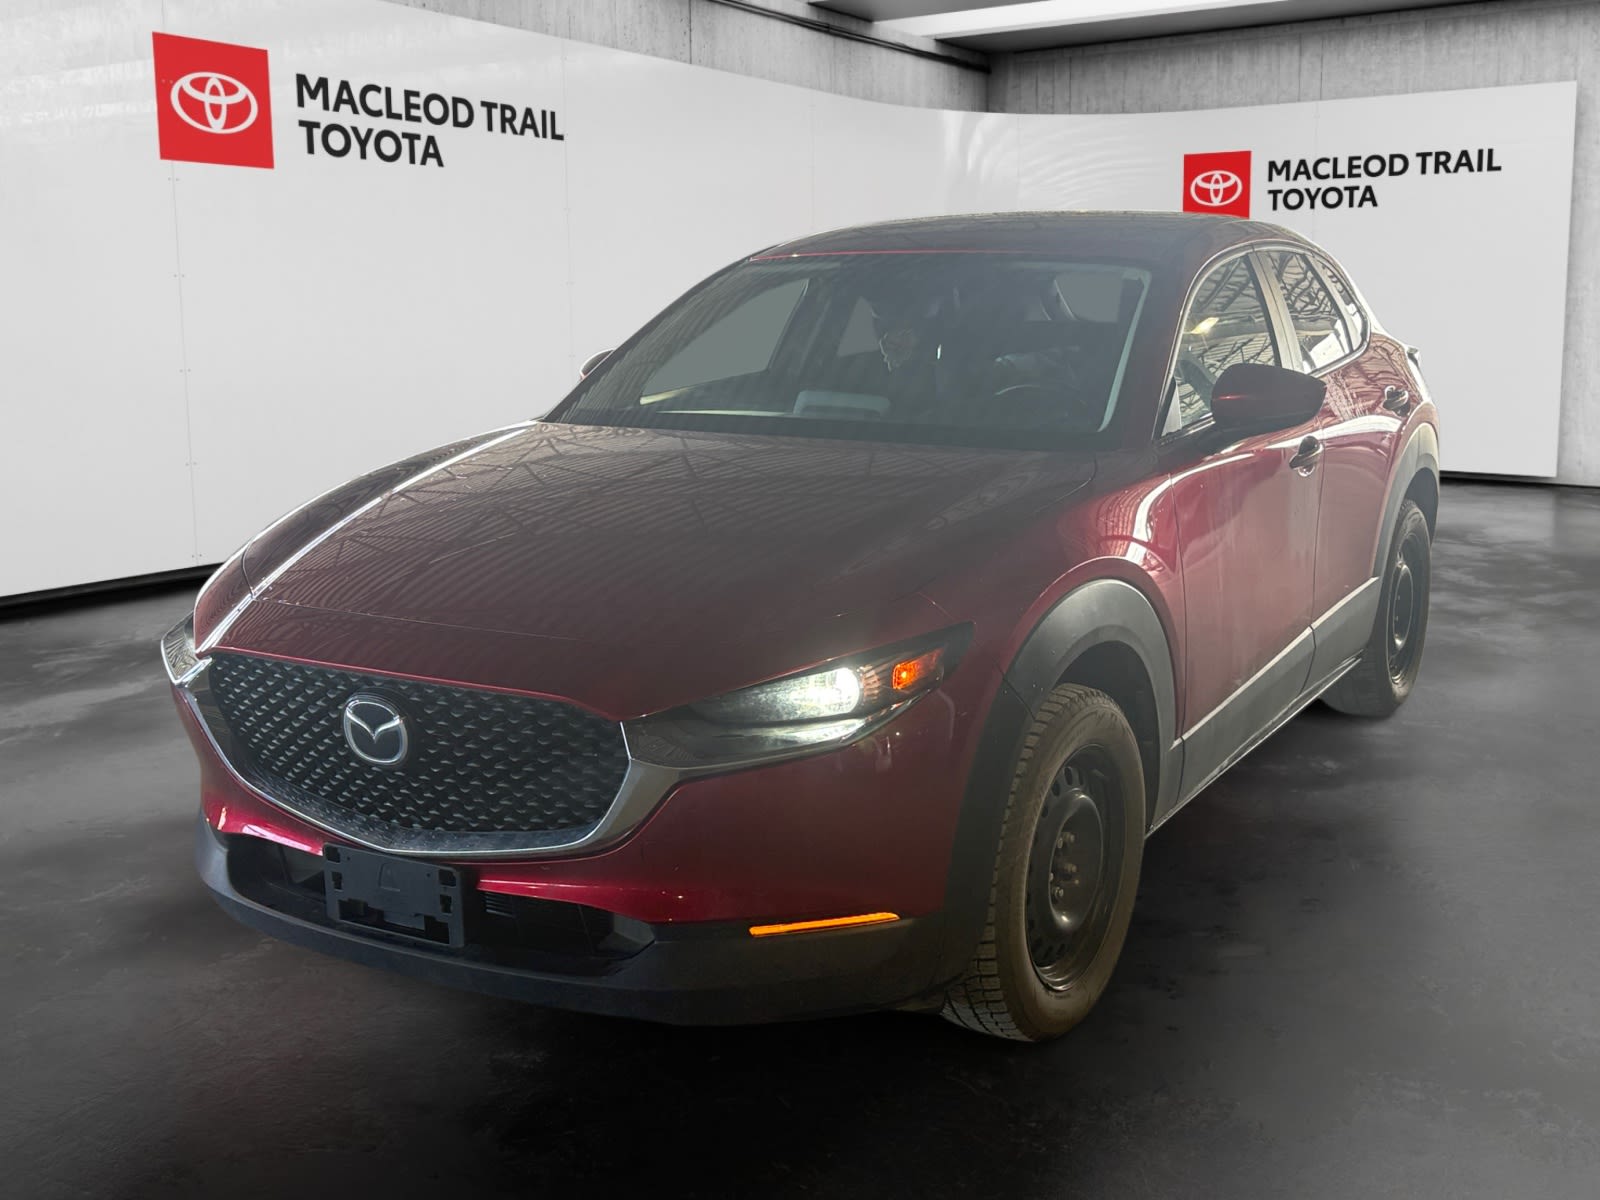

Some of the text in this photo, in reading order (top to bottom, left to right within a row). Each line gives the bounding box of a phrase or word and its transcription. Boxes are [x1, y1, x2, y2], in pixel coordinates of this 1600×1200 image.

[295, 73, 565, 141] MACLEOD TRAIL
[298, 119, 445, 168] TOYOTA
[1267, 148, 1502, 183] MACLEOD TRAIL
[1267, 185, 1378, 212] TOYOTA
